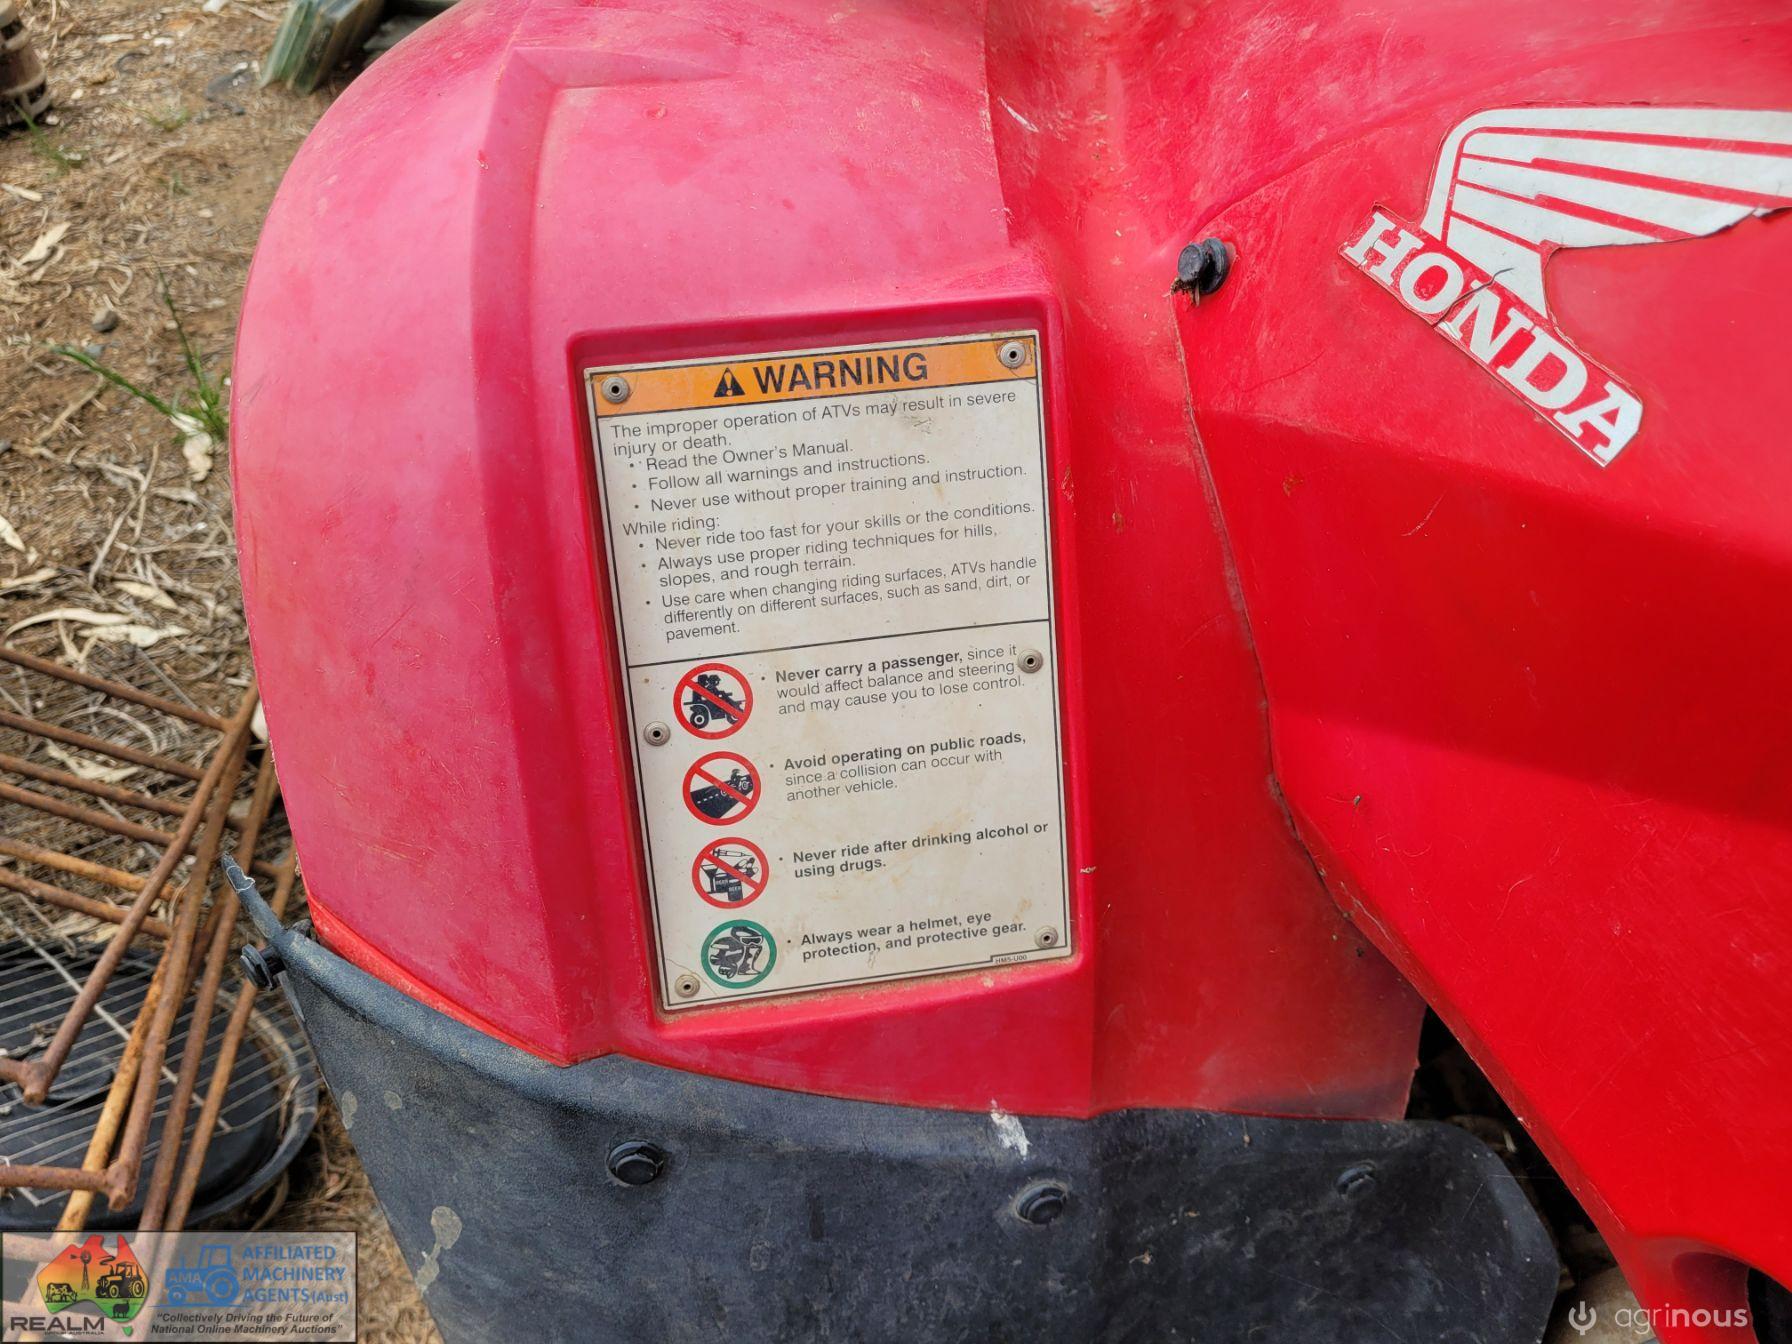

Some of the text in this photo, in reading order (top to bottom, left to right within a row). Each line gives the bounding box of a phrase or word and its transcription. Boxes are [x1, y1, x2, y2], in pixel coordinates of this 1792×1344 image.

[1344, 211, 1642, 465] HONDA
[753, 352, 928, 394] WARNING
[609, 391, 1016, 439] The improper operation of ATVs may result in severe
[613, 433, 732, 459] injury or death.
[645, 439, 853, 471] Read the Owner's Manual.
[648, 453, 930, 491] Follow all warnings and instructions.
[650, 464, 1027, 513] Never use without proper training and instruction.
[622, 515, 721, 537] While riding:
[655, 502, 1035, 551] Never ride too fast for your skills or the conditions.
[657, 523, 997, 571] Always use proper riding techniques for hills,
[659, 554, 856, 589] slopes, and rough terrain.
[661, 593, 691, 608] Use
[694, 591, 726, 605] care
[729, 585, 768, 601] when
[771, 577, 838, 596] changing
[841, 573, 881, 588] riding
[950, 561, 986, 577] ATVs
[990, 556, 1037, 573] handle
[663, 604, 733, 625] differently
[737, 604, 756, 616] on
[759, 595, 817, 614] different
[886, 583, 920, 599] such
[923, 584, 941, 595] as
[944, 577, 981, 593] sand,
[985, 574, 1012, 589] dirt,
[1016, 575, 1031, 586] or
[665, 621, 740, 644] pavement.
[775, 643, 1017, 684] Never carry a passenger, since it
[776, 661, 1015, 699] would affect balance and steering
[778, 675, 1025, 715] and may cause you to lose control.
[783, 731, 1026, 771] Avoid operating on public roads,
[785, 748, 1003, 787] since a collision can occur with
[786, 777, 898, 802] another vehicle.
[793, 822, 1049, 864] Never ride after drinking alcohol or
[794, 858, 887, 879] using drugs.
[800, 912, 992, 947] Always wear a helmet, eye
[802, 922, 1027, 963] protection, and protective gear.
